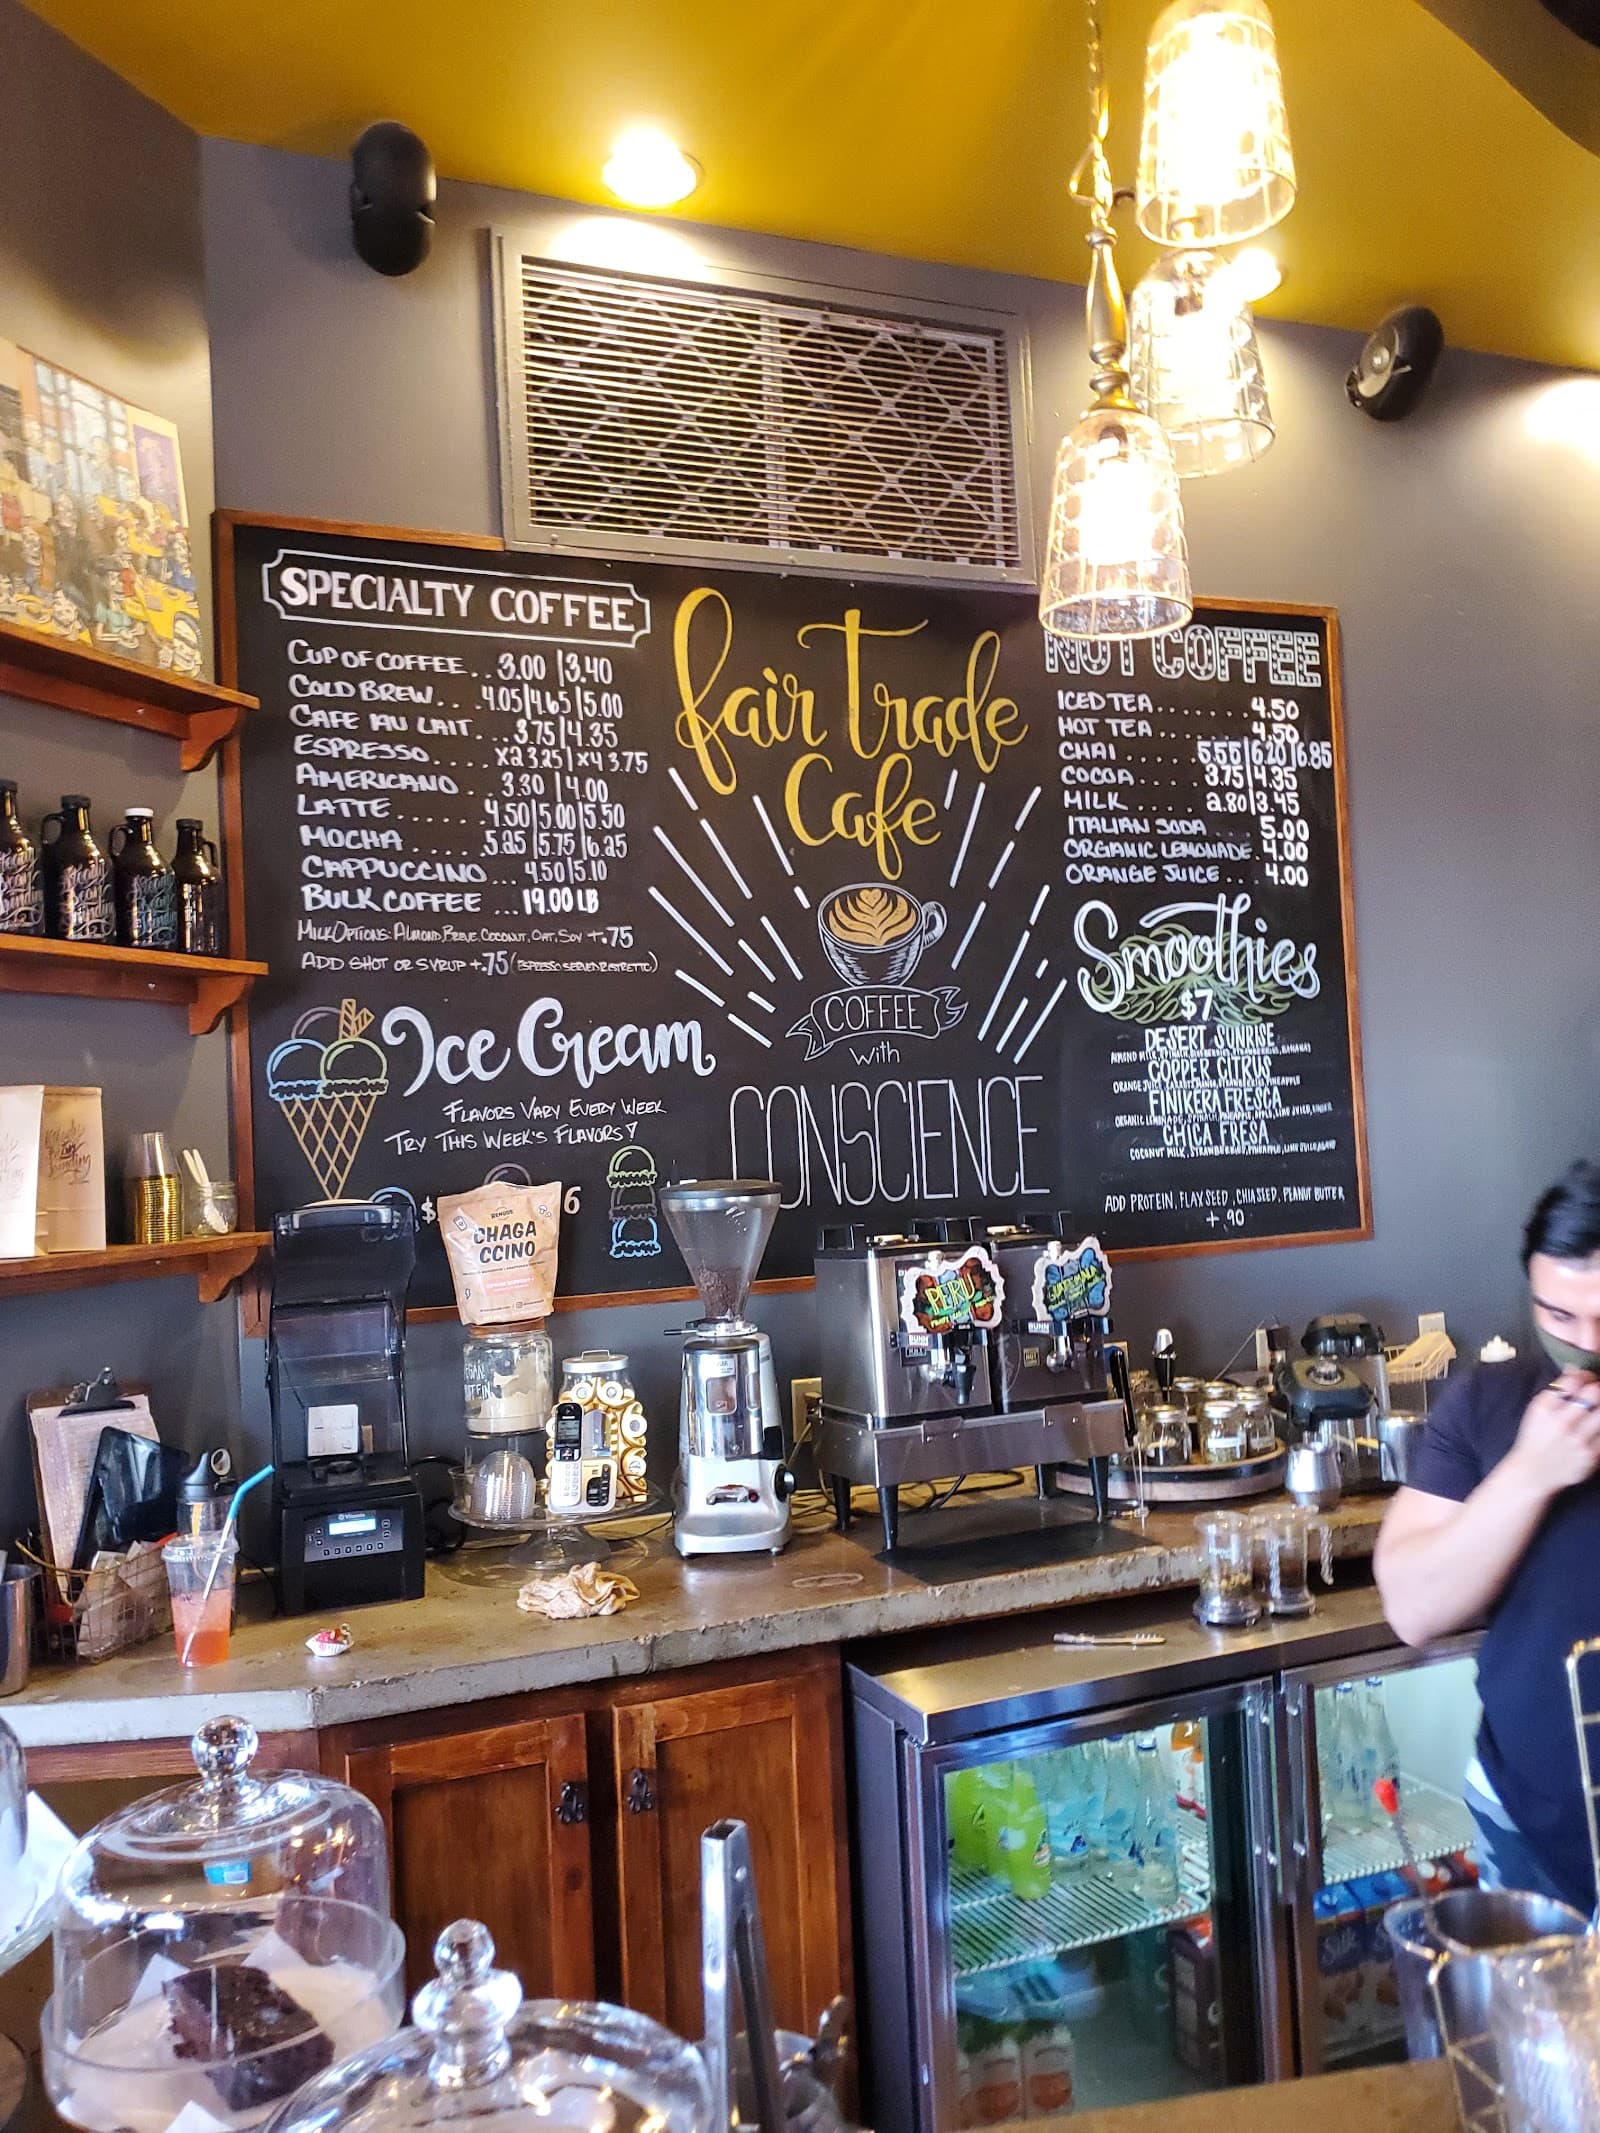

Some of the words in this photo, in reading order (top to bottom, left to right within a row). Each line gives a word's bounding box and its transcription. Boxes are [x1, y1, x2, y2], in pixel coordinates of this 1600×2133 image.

[280, 567, 475, 618] SPECIALTY
[490, 587, 635, 633] COFFEE
[344, 649, 372, 669] OF
[374, 651, 468, 676] COFFEE
[497, 653, 546, 682] 3.00
[1152, 624, 1322, 688] COFFEE
[287, 673, 355, 698] COLD
[673, 587, 828, 795] fair
[1057, 690, 1106, 711] ICED
[1105, 692, 1154, 713] TEA
[1251, 697, 1300, 720] 4.50
[289, 704, 361, 731] CAFE
[416, 717, 474, 739] LAIT
[1057, 717, 1100, 737] HOT
[1105, 717, 1153, 738] TEA
[1251, 721, 1300, 745] 4.50
[294, 734, 430, 765] ESPRESSO
[1058, 741, 1117, 761] CHAI
[296, 762, 460, 796] AMERICANO
[502, 772, 546, 798] 3.30
[1061, 767, 1135, 786] COCOA
[296, 794, 393, 819] LATTE
[1063, 790, 1129, 811] MILK
[784, 752, 942, 881] Cafe
[1067, 815, 1151, 836] ITALIAN
[1155, 818, 1207, 836] SODA
[1259, 816, 1310, 840] 5.00
[300, 825, 402, 851] MOCHA
[1063, 838, 1158, 860] ORGANIC
[1161, 841, 1253, 862] LEMONADE
[1262, 840, 1309, 863] 4.00
[301, 855, 488, 884] CAPPUCCINO
[1065, 864, 1156, 885] ORANGE
[1161, 864, 1220, 884] JUICE
[1265, 865, 1309, 887] 4.00
[301, 884, 383, 913] BULK
[382, 890, 482, 914] COFFEE
[522, 888, 573, 915] 19.00
[576, 889, 600, 914] LB
[301, 952, 346, 971] ADD
[350, 954, 389, 971] SHOT
[393, 959, 414, 971] OR
[414, 957, 468, 973] SYRUP
[1073, 892, 1321, 1014] Smoothies
[824, 994, 923, 1033] COFFEE
[1180, 988, 1214, 1021] $7
[381, 1005, 511, 1098] Ice
[516, 996, 718, 1089] Cream
[1144, 1024, 1207, 1053] DESERT
[1214, 1022, 1276, 1049] SUNRISE
[849, 1040, 901, 1067] with
[1147, 1057, 1210, 1083] COPPER
[1216, 1054, 1273, 1080] CITRUS
[442, 1099, 517, 1124] FLAVORS
[518, 1097, 562, 1122] VARY
[568, 1097, 617, 1119] EVERY
[619, 1097, 668, 1117] WEEK
[1224, 1085, 1284, 1114] FRESCA
[384, 1129, 427, 1156] TRY
[434, 1128, 478, 1152] THIS
[481, 1127, 549, 1151] WEEK'S
[729, 1075, 1051, 1209] CONSCIENCE
[1162, 1123, 1213, 1148] CHICA
[1220, 1120, 1271, 1145] FRESA
[1129, 1147, 1165, 1161] COCONUT
[1104, 1193, 1126, 1214] ADD
[1281, 1186, 1312, 1203] PEANUT
[1313, 1184, 1346, 1202] BUTTER
[473, 1221, 537, 1245] CHAGA
[479, 1240, 537, 1264] CCINO
[925, 1271, 976, 1316] PERU
[1028, 1321, 1050, 1334] BUNN
